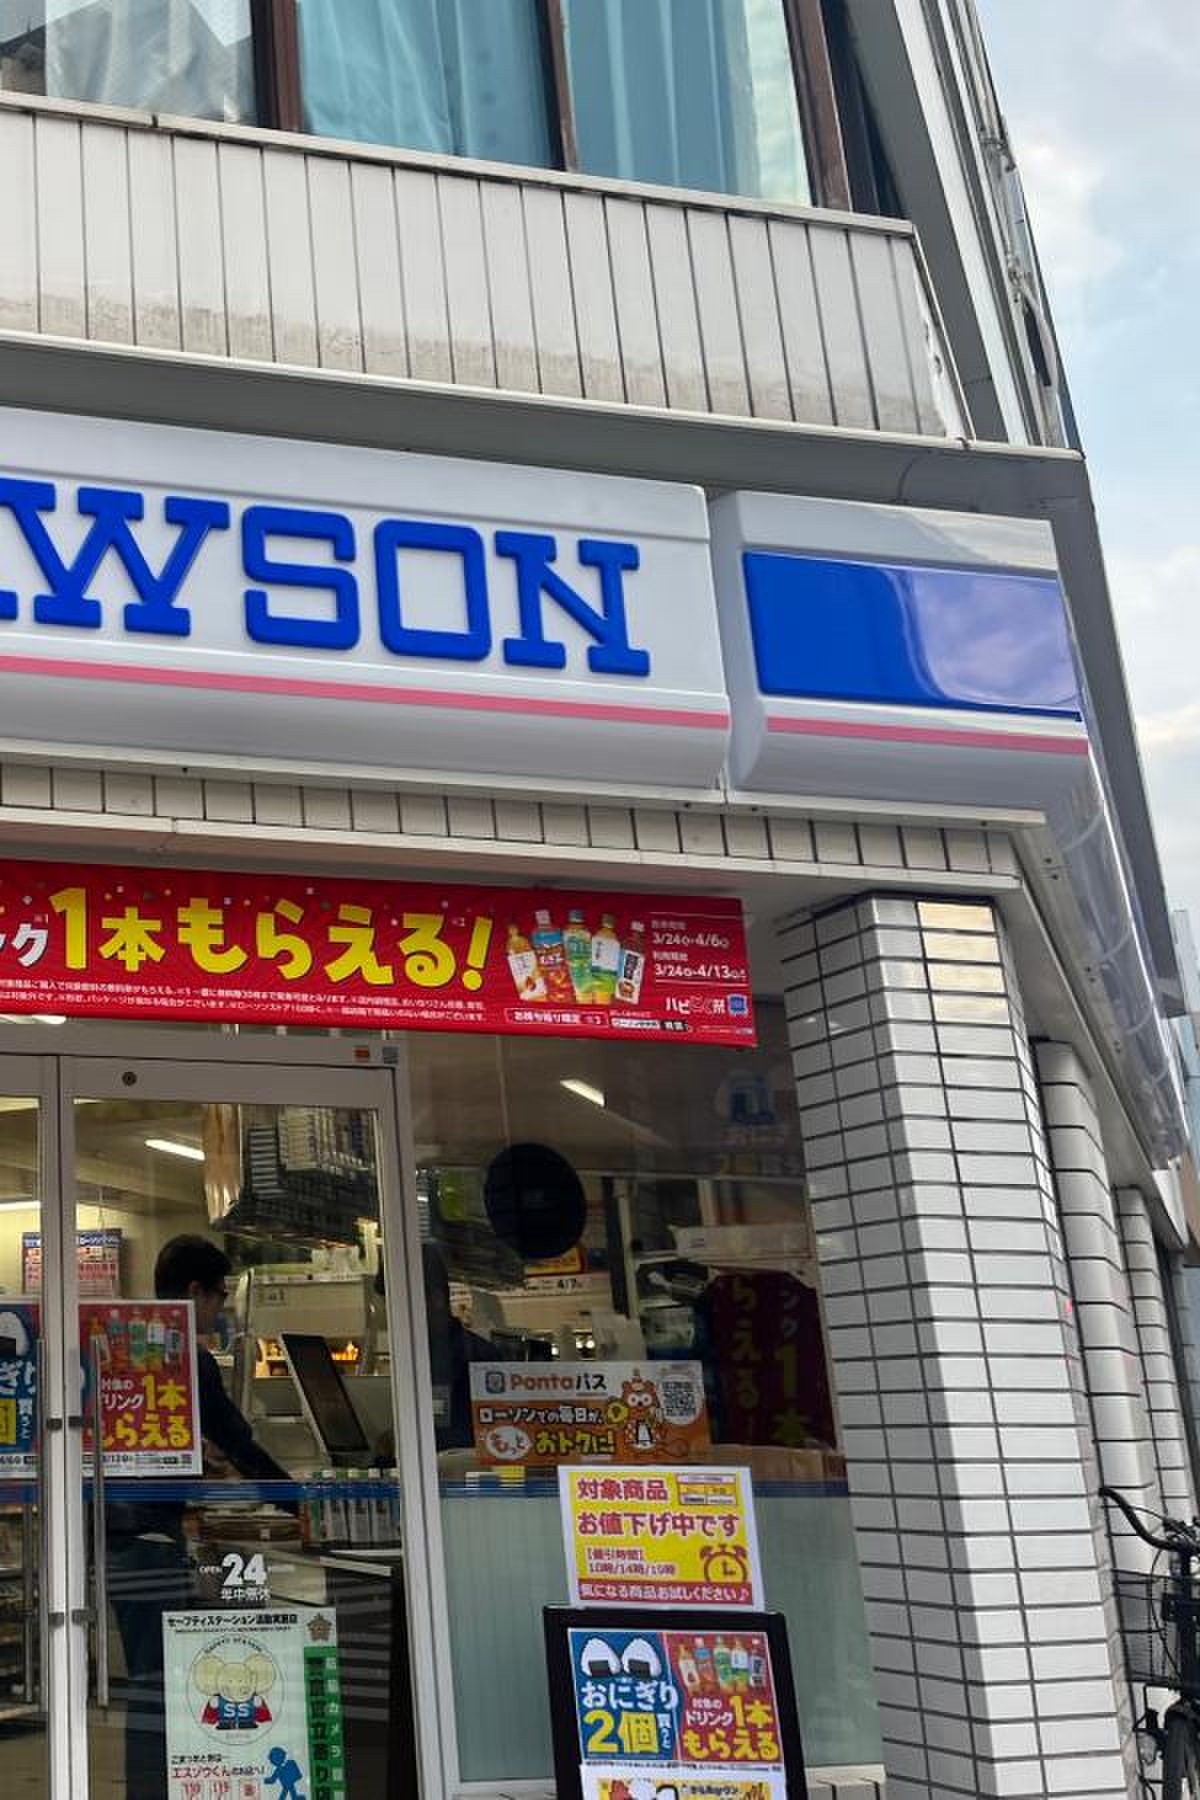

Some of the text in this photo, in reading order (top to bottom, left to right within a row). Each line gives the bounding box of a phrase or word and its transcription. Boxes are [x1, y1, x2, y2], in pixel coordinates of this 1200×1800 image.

[102, 1393, 144, 1411] リンク
[102, 1411, 192, 1449] らえる
[578, 1478, 669, 1501] 対象商品
[578, 1512, 740, 1537] お値下げ中です
[221, 1553, 267, 1587] 24
[580, 1680, 679, 1711] おにぎり
[686, 1709, 734, 1726] ドリンク
[730, 1695, 774, 1728] 1本
[584, 1709, 659, 1753] 2個
[683, 1728, 780, 1760] もらえる
